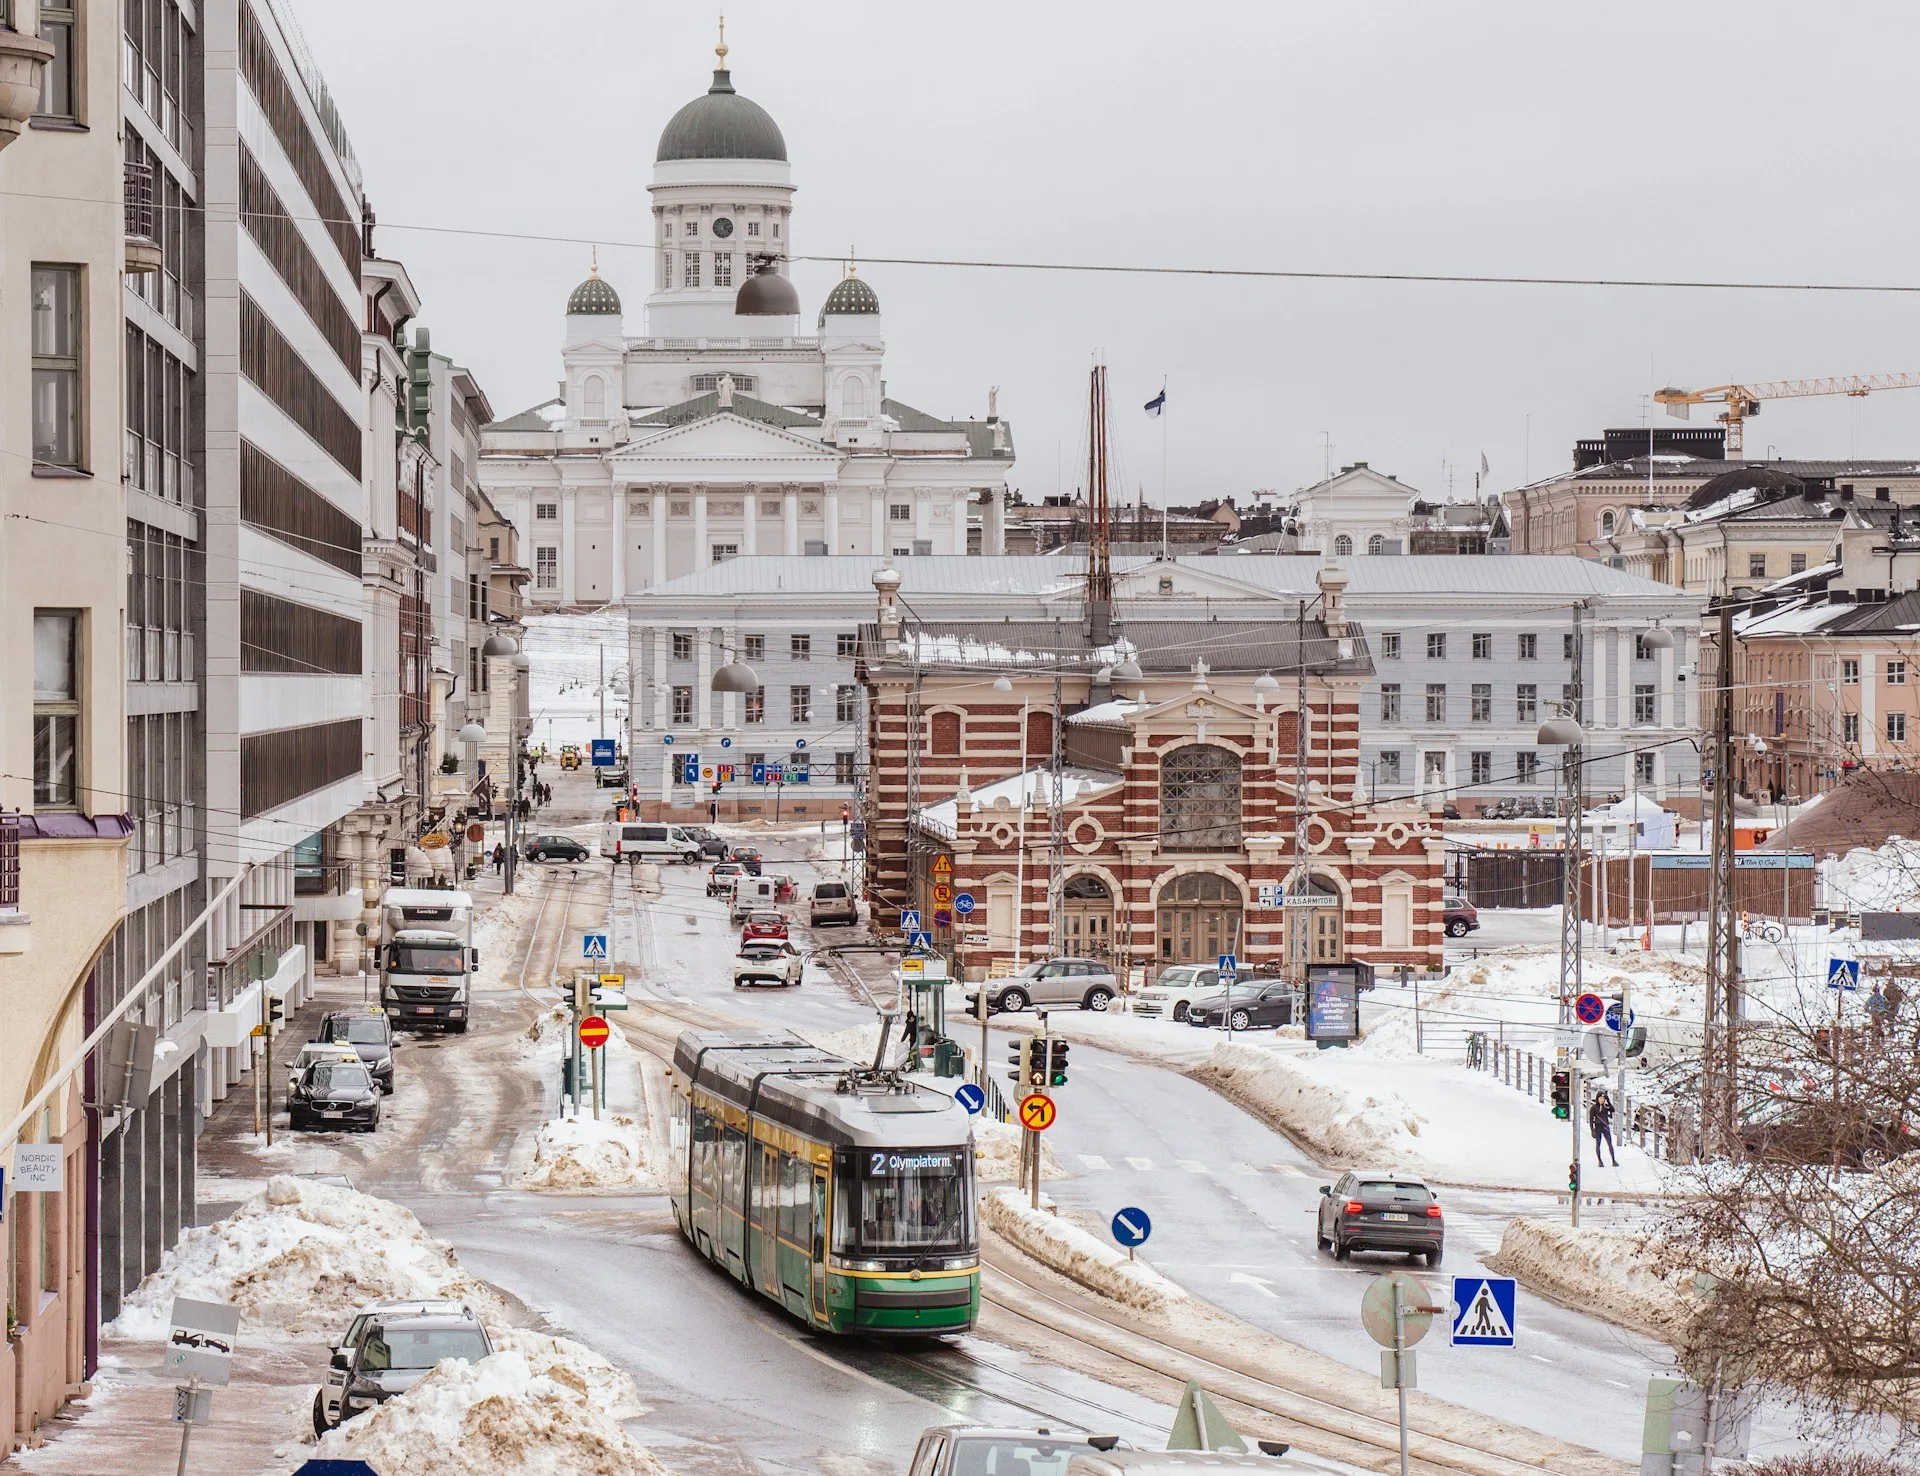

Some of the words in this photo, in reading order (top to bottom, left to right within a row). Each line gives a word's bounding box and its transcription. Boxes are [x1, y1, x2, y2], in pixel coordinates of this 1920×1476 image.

[20, 1164, 57, 1174] BEAUTY
[871, 1153, 886, 1175] 2
[889, 1155, 952, 1170] Olympiaterm.
